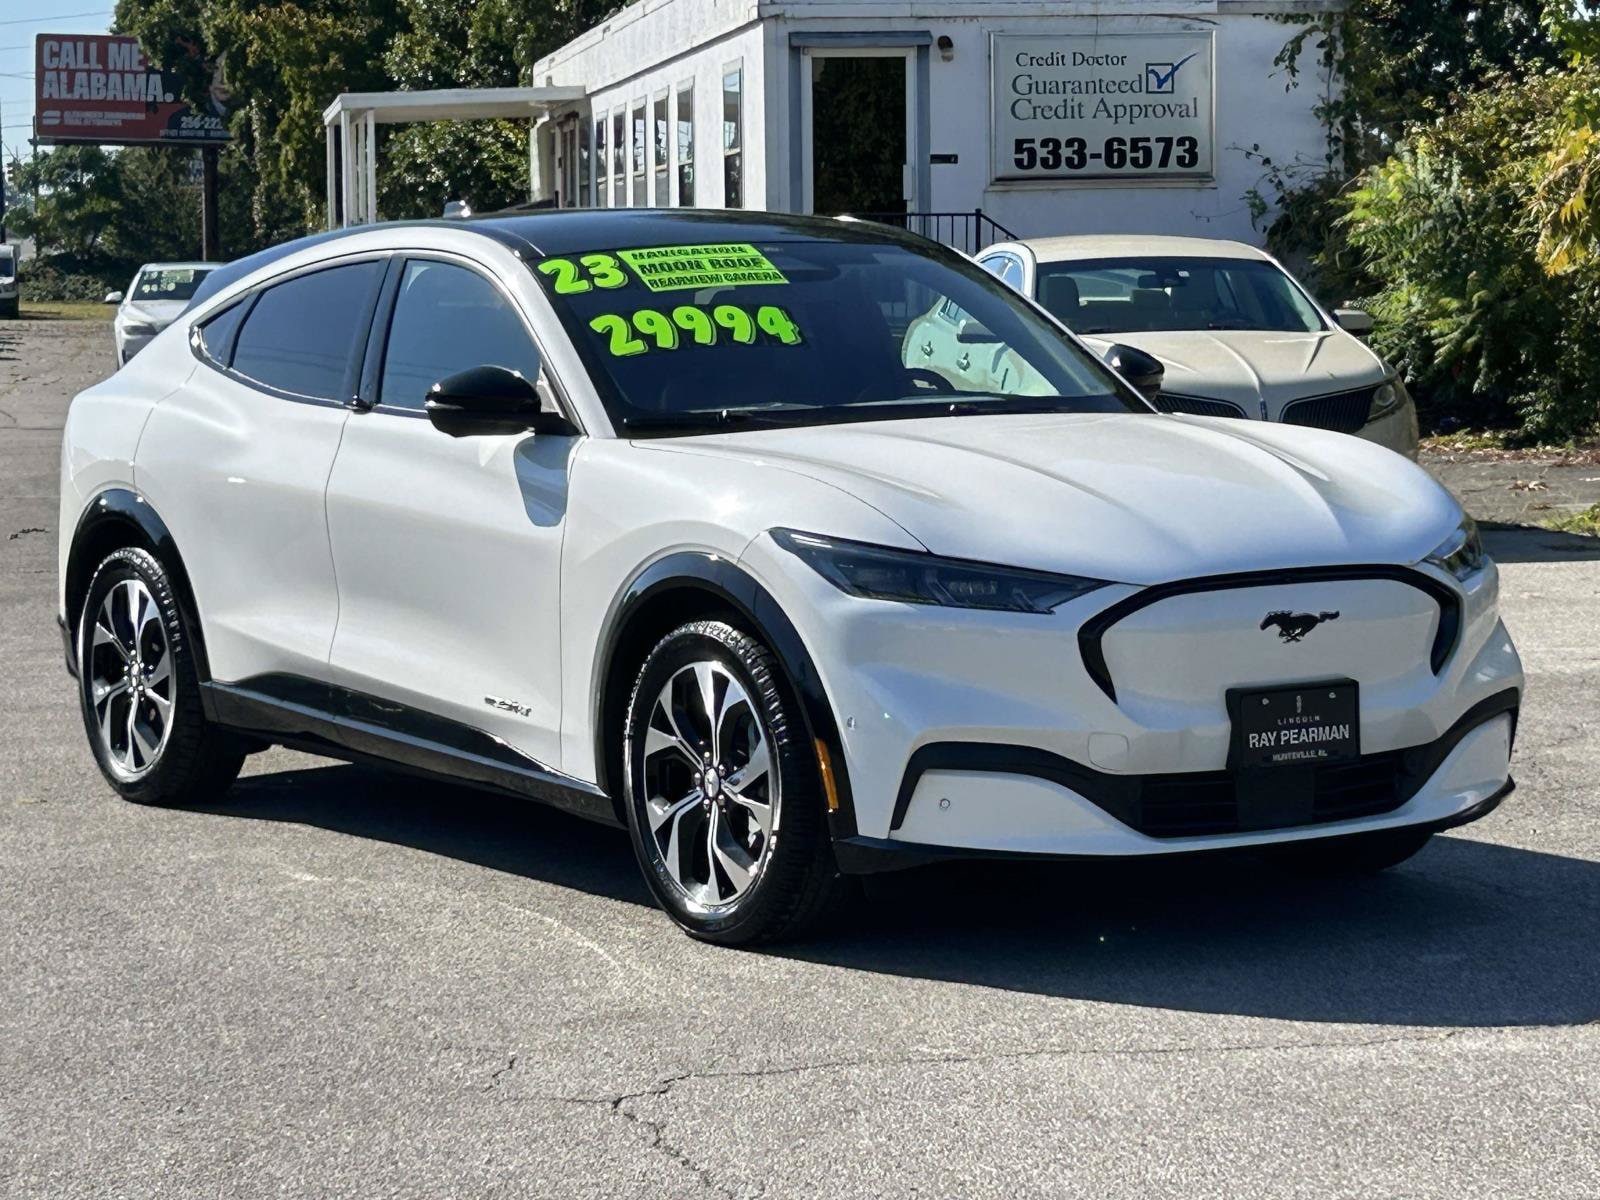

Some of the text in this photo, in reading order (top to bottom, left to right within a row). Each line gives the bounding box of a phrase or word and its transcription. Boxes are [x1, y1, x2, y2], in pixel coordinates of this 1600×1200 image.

[43, 40, 145, 71] CALL ME
[1015, 52, 1128, 67] Credit Doctor
[43, 71, 175, 103] ALABAMA.
[1011, 73, 1143, 95] Guaranteed
[1010, 97, 1198, 125] Credit Approval
[1014, 136, 1199, 170] 533-6573
[631, 246, 748, 260] NAVIGATION
[638, 257, 763, 275] MOON ROOF
[537, 254, 629, 294] 23
[648, 271, 782, 289] REARVIEW CAMERA
[589, 305, 802, 357] 29994
[1277, 715, 1320, 726] LINCOLN
[1249, 723, 1350, 749] RAY PEARMAN
